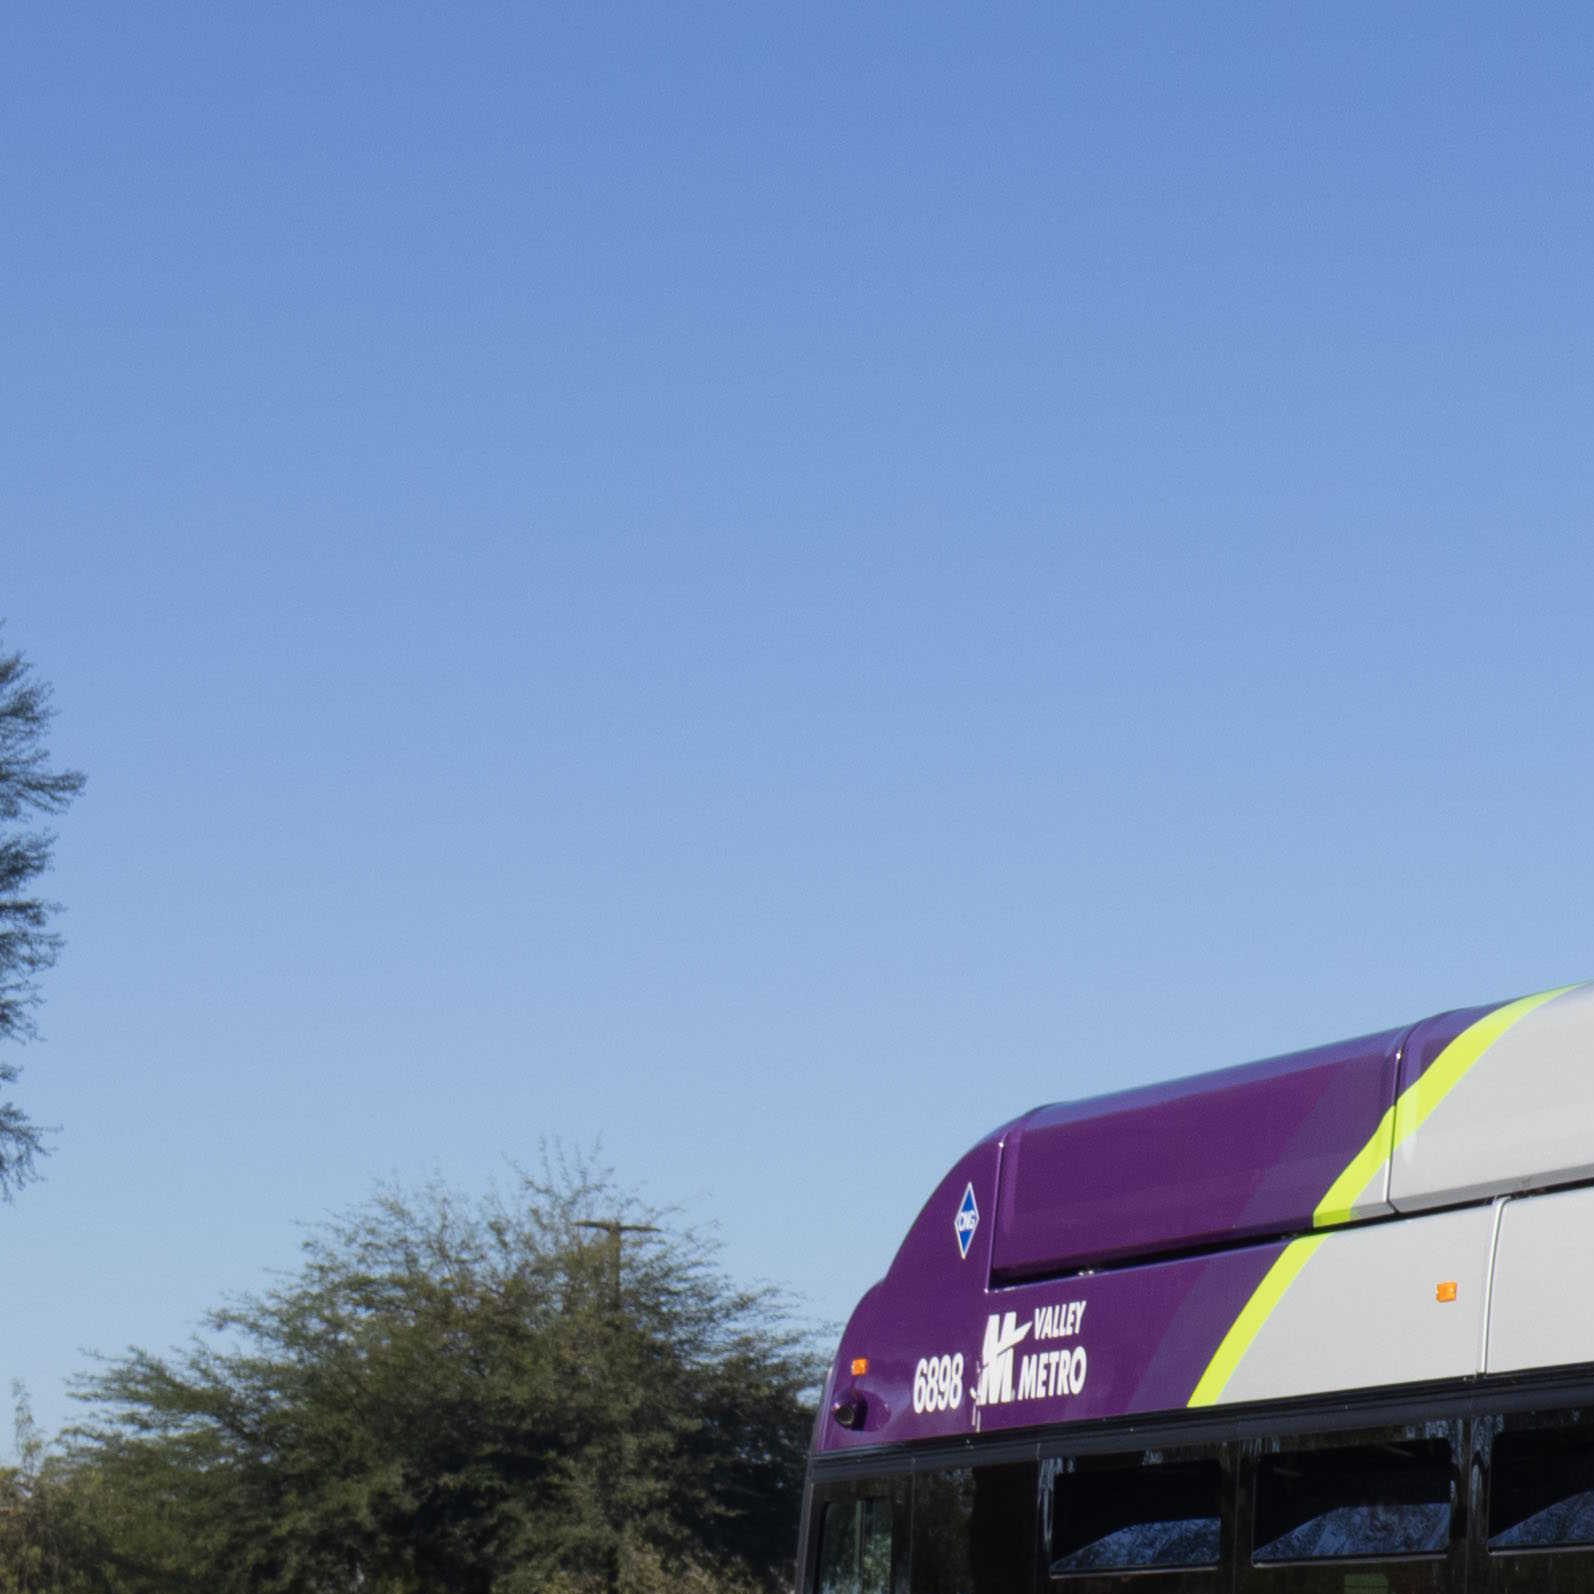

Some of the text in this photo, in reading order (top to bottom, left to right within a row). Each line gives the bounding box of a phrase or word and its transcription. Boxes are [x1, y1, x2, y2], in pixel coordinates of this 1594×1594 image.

[1034, 1300, 1087, 1341] VALLEY
[913, 1352, 964, 1414] 6898
[1017, 1345, 1088, 1401] METRO
